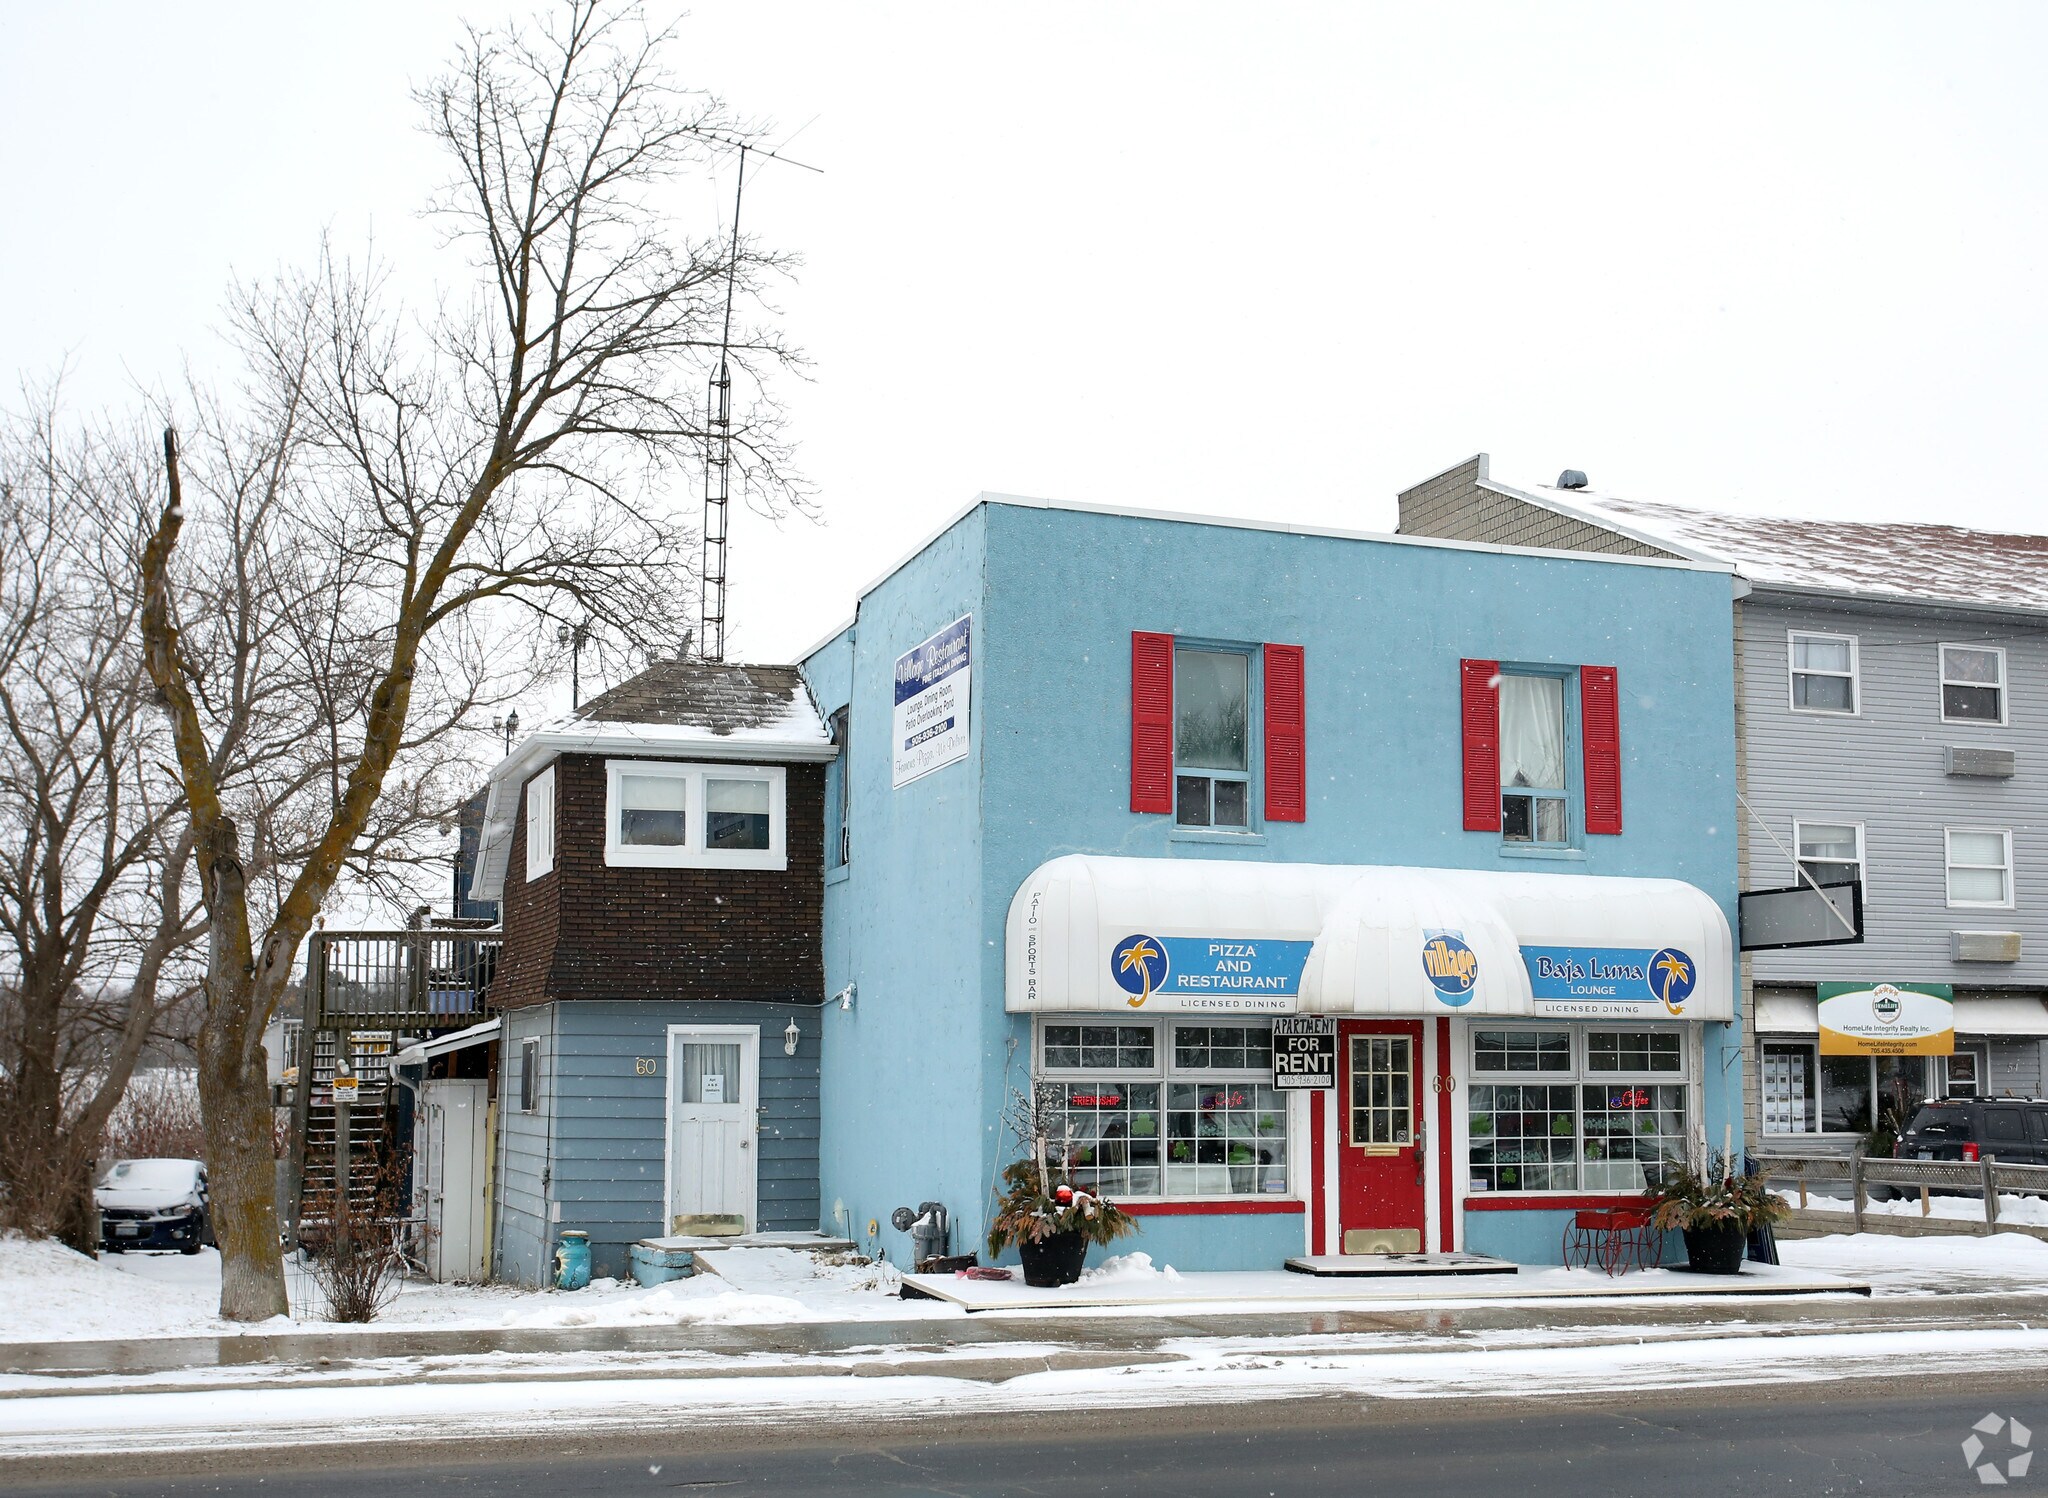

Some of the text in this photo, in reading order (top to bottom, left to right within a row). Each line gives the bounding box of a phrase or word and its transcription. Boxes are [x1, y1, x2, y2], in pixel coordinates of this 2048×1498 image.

[896, 628, 967, 685] Village Restaurant
[933, 661, 951, 679] ITALIAN
[924, 691, 938, 706] Dining
[905, 695, 955, 731] Patio Overlooking Pond
[1028, 892, 1041, 924] PATIO
[1028, 934, 1037, 975] SPORTS
[1208, 944, 1256, 957] PIZZA
[1215, 960, 1251, 972] AND
[1423, 940, 1477, 988] village
[1536, 956, 1645, 984] Baja Luna
[1028, 978, 1037, 999] BAR
[1178, 974, 1287, 989] RESTAURANT
[1570, 985, 1616, 995] LOUNGE
[1181, 1000, 1286, 1008] LICENSED DINING
[1545, 1005, 1598, 1013] LICENSED
[1274, 1019, 1335, 1034] APARTMENT
[1874, 1025, 1899, 1033] Integrity
[1900, 1025, 1918, 1033] Realty
[1288, 1037, 1319, 1051] FOR
[636, 1058, 656, 1075] 60
[1275, 1052, 1333, 1073] RENT
[1432, 1075, 1456, 1094] 60
[1072, 1096, 1120, 1106] FRIENDSHIP
[1496, 1093, 1536, 1110] OPEN
